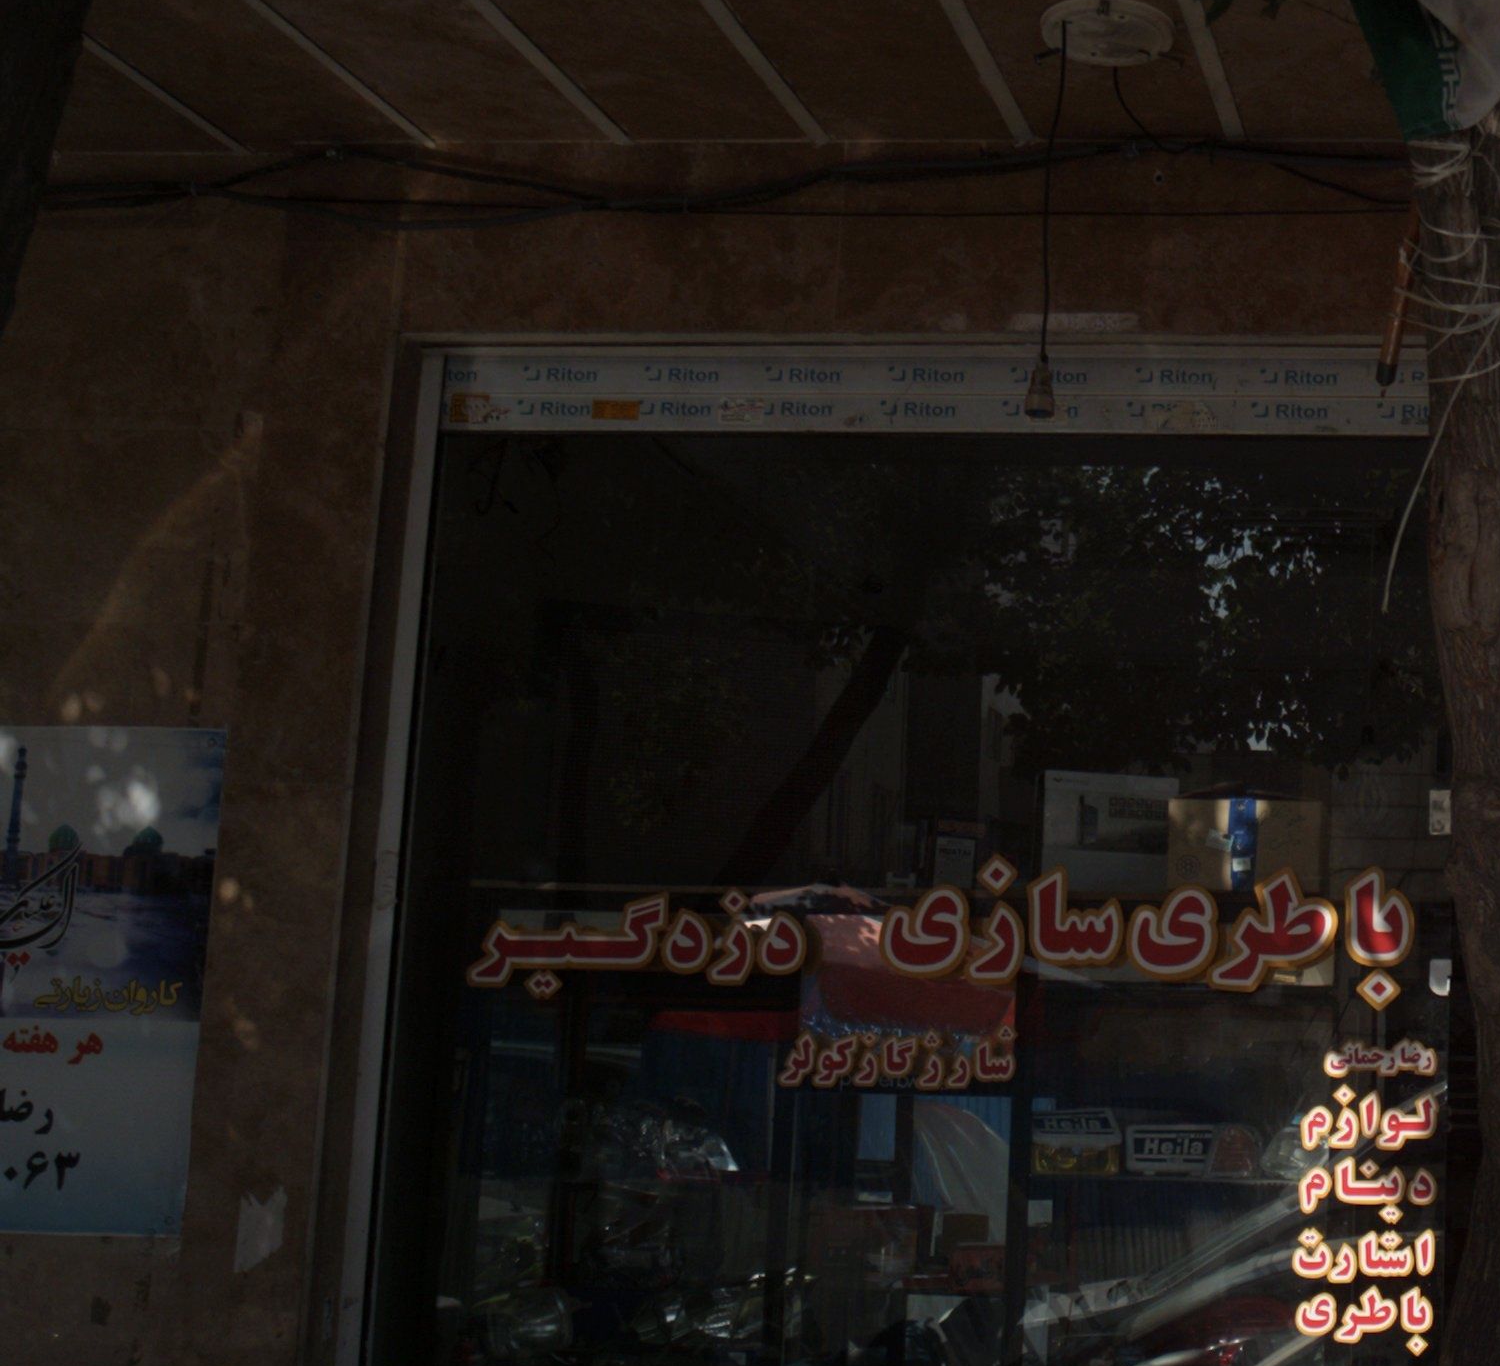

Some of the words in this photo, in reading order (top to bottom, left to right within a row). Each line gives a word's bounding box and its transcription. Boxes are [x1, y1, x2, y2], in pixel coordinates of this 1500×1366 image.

[446, 367, 477, 383] ton
[547, 367, 597, 383] Riton
[668, 367, 719, 383] Riton
[789, 367, 841, 383] Riton
[912, 367, 964, 383] Riton
[1160, 369, 1213, 384] Riton
[1284, 370, 1337, 385] Riton
[540, 402, 590, 417] Riton
[661, 402, 711, 417] Riton
[780, 402, 832, 417] Riton
[904, 402, 956, 417] Riton
[1275, 403, 1328, 419] Riton
[468, 891, 806, 998] دزدگیر
[880, 855, 1122, 983] سازی
[1130, 866, 1413, 1010] باطری
[104, 979, 182, 1015] کاروان
[3, 1025, 59, 1053] هفته
[67, 1032, 103, 1065] هر
[778, 1031, 856, 1087] کولر
[852, 1032, 916, 1087] گاز
[917, 1026, 1016, 1089] شارژ
[1324, 1044, 1397, 1077] رحمانی
[1397, 1039, 1436, 1075] رضا
[1302, 1086, 1436, 1150] لوازم
[1300, 1157, 1436, 1224] دینام
[1293, 1229, 1435, 1283] استارت
[1296, 1286, 1433, 1357] باطری
